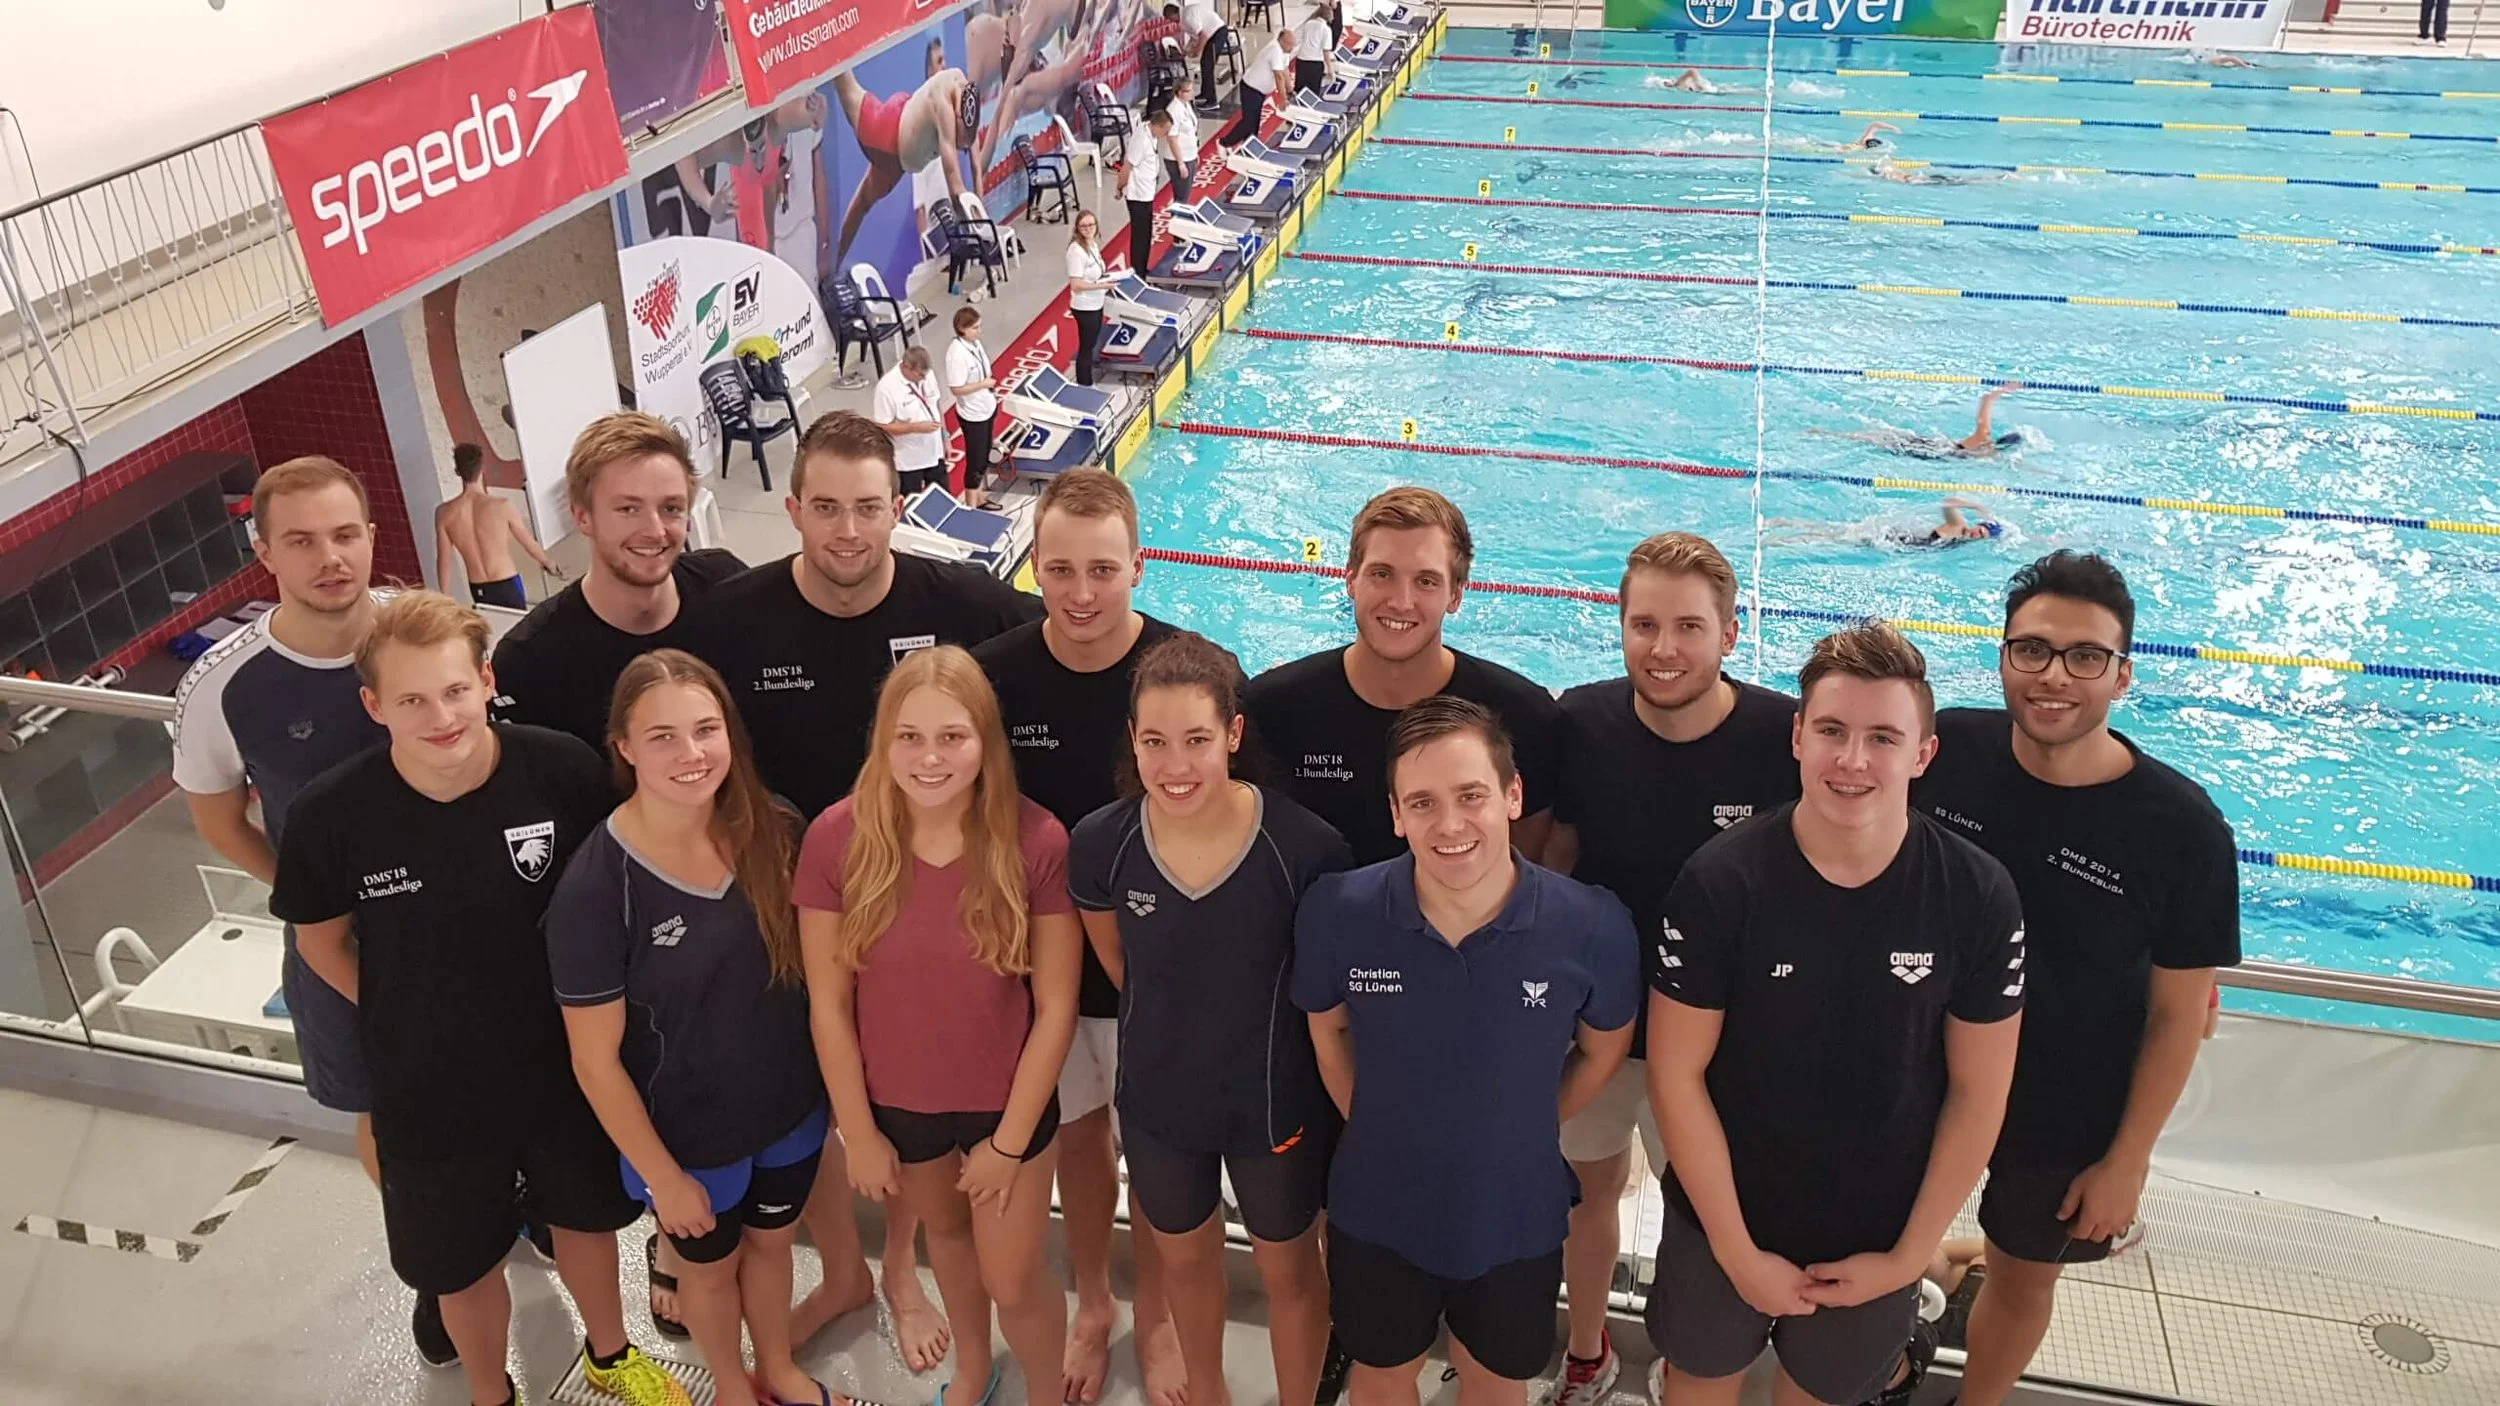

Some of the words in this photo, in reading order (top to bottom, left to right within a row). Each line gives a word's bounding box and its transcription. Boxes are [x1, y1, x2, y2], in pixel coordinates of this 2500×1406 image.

[1396, 8, 1403, 19] 9
[2021, 15, 2197, 41] Bürotechnik
[1367, 42, 1375, 52] 8
[1334, 81, 1342, 91] 7
[1294, 127, 1302, 138] 6
[311, 93, 522, 255] speedo
[1246, 181, 1255, 194] 5
[1480, 182, 1487, 192] 6
[1189, 248, 1199, 261] 4
[1466, 245, 1474, 256] 5
[734, 271, 760, 311] SV
[733, 303, 760, 326] BAYER
[1120, 329, 1131, 344] 3
[1447, 324, 1455, 336] 4
[1404, 422, 1413, 434] 3
[1030, 430, 1042, 447] 2
[1306, 542, 1316, 556] 2
[762, 665, 803, 678] DMS'18
[763, 677, 815, 691] Bundesliga
[1011, 737, 1060, 750] Bundesliga
[1304, 754, 1343, 765] DMS'18
[1303, 767, 1354, 781] Bundesliga
[1713, 804, 1753, 817] arena
[1948, 812, 1984, 833] LÜNEN
[2046, 854, 2058, 866] 2.
[2060, 846, 2087, 866] DMS
[2089, 860, 2122, 882] 2014
[363, 866, 408, 886] DMS'18
[367, 879, 423, 899] Bundesliga
[1127, 889, 1156, 904] arena
[651, 914, 684, 938] arena
[1890, 951, 1934, 967] arena
[1349, 967, 1401, 980] Christian
[1770, 963, 1794, 978] JP
[1348, 981, 1363, 992] SG
[1365, 981, 1403, 993] Lünen
[1521, 996, 1548, 1009] TYR
